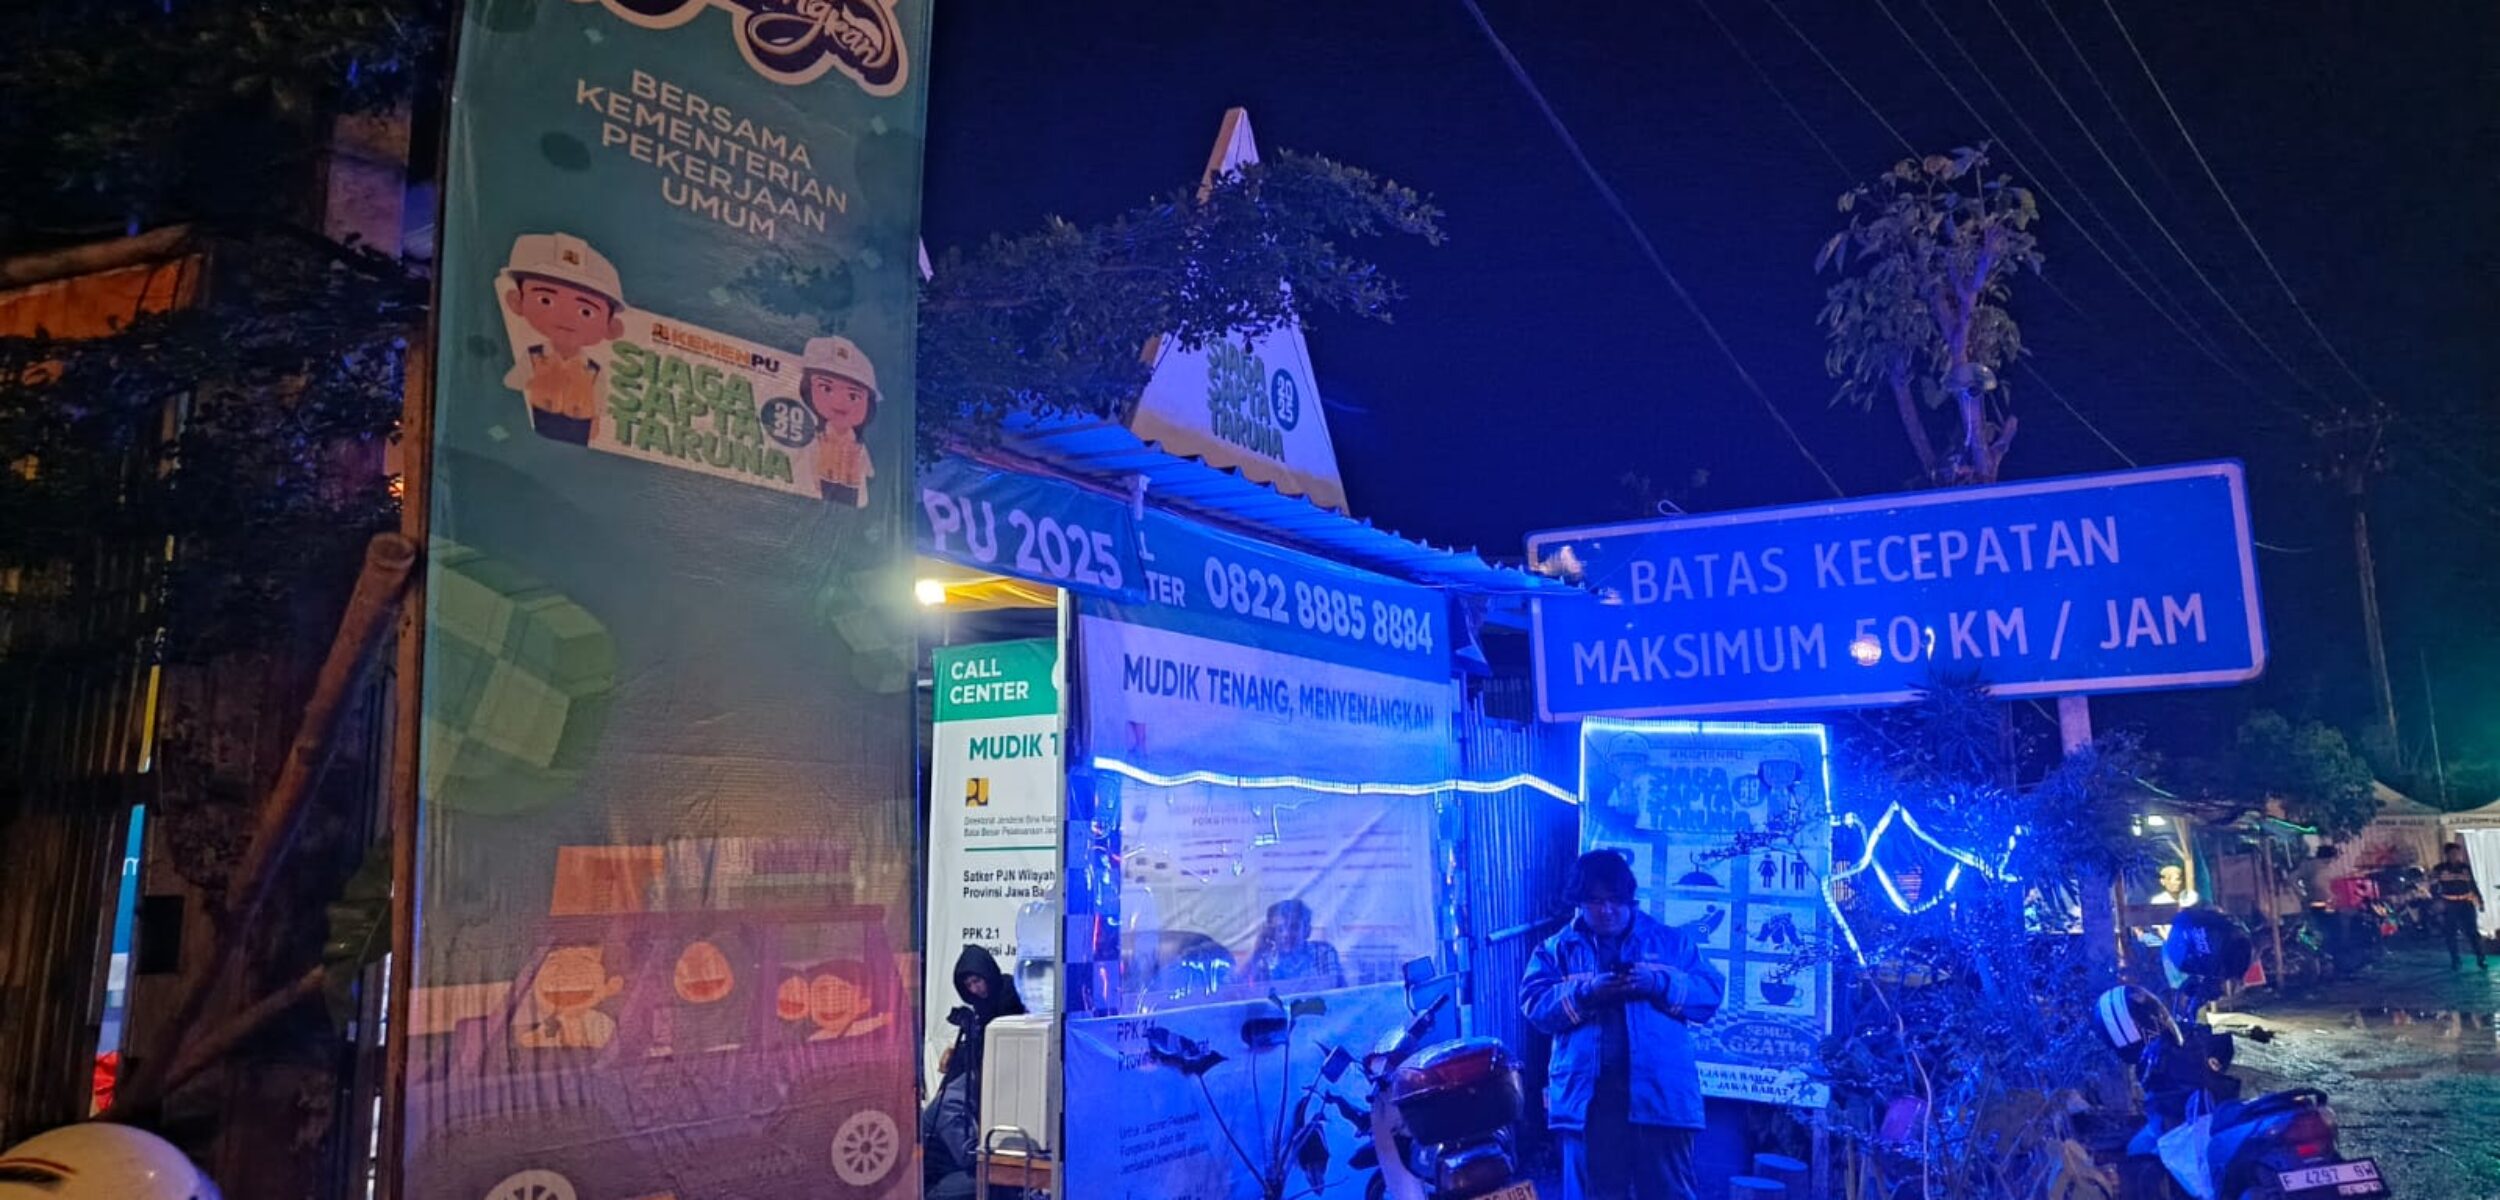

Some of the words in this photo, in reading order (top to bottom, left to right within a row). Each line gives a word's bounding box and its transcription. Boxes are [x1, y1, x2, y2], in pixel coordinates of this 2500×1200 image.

[575, 79, 847, 213] KEMENTERIAN
[631, 69, 812, 170] BERSAMA
[602, 121, 826, 233] PEKERJAAN
[661, 177, 775, 241] UMUM
[610, 340, 756, 413] SIAGA
[671, 328, 780, 374] KEMENPU
[608, 374, 764, 447] SAPTA
[773, 402, 805, 422] 20
[1207, 366, 1271, 425] SAPTA
[607, 406, 793, 484] TARUNA
[773, 418, 802, 441] 25
[1207, 400, 1285, 463] TARUNA
[922, 489, 997, 563] PU
[1007, 508, 1124, 591] 2025
[1630, 546, 1788, 606] BATAS
[1813, 514, 2121, 590] KECEPATAN
[1204, 556, 1290, 625] 0822
[1297, 583, 1366, 640] 8885
[1372, 599, 1433, 655] 8884
[951, 658, 1002, 680] CALL
[1572, 620, 1828, 687] MAKSIMUM
[1853, 615, 1920, 665] 50
[1948, 600, 2030, 661] KM
[2100, 592, 2208, 652] JAM
[950, 681, 1029, 704] CENTER
[1122, 653, 1200, 701] MUDIK
[1206, 667, 1295, 723] TENANG,
[1299, 683, 1434, 732] MENYENANGKAN
[969, 733, 1043, 761] MUDIK
[963, 870, 993, 882] Satker
[996, 869, 1016, 881] PJN
[1018, 868, 1056, 884] Wilayah
[963, 886, 1002, 898] Provinsi
[1004, 887, 1030, 898] Jawa
[962, 928, 983, 940] PPK
[985, 928, 1000, 940] 2.1
[1116, 1021, 1139, 1042] PPK
[1744, 1023, 1793, 1039] SEMUA
[2282, 1174, 2294, 1189] F
